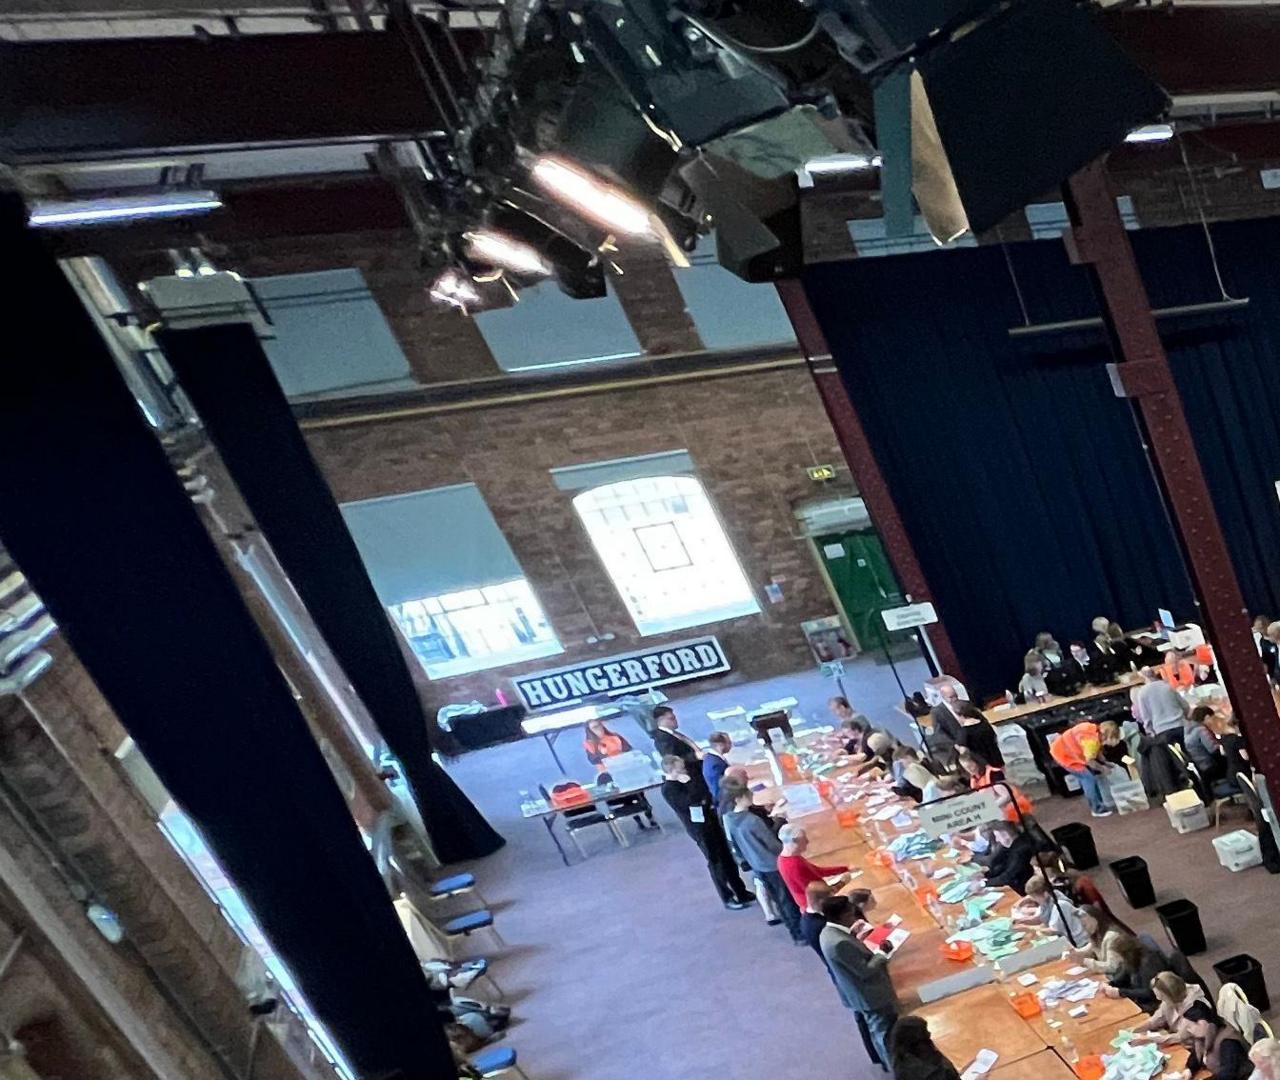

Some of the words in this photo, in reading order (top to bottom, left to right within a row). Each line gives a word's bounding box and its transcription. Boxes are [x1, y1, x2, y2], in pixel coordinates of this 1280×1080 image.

[521, 644, 719, 706] HUNGERFORD
[953, 802, 985, 816] COUNT
[946, 817, 972, 829] AREA
